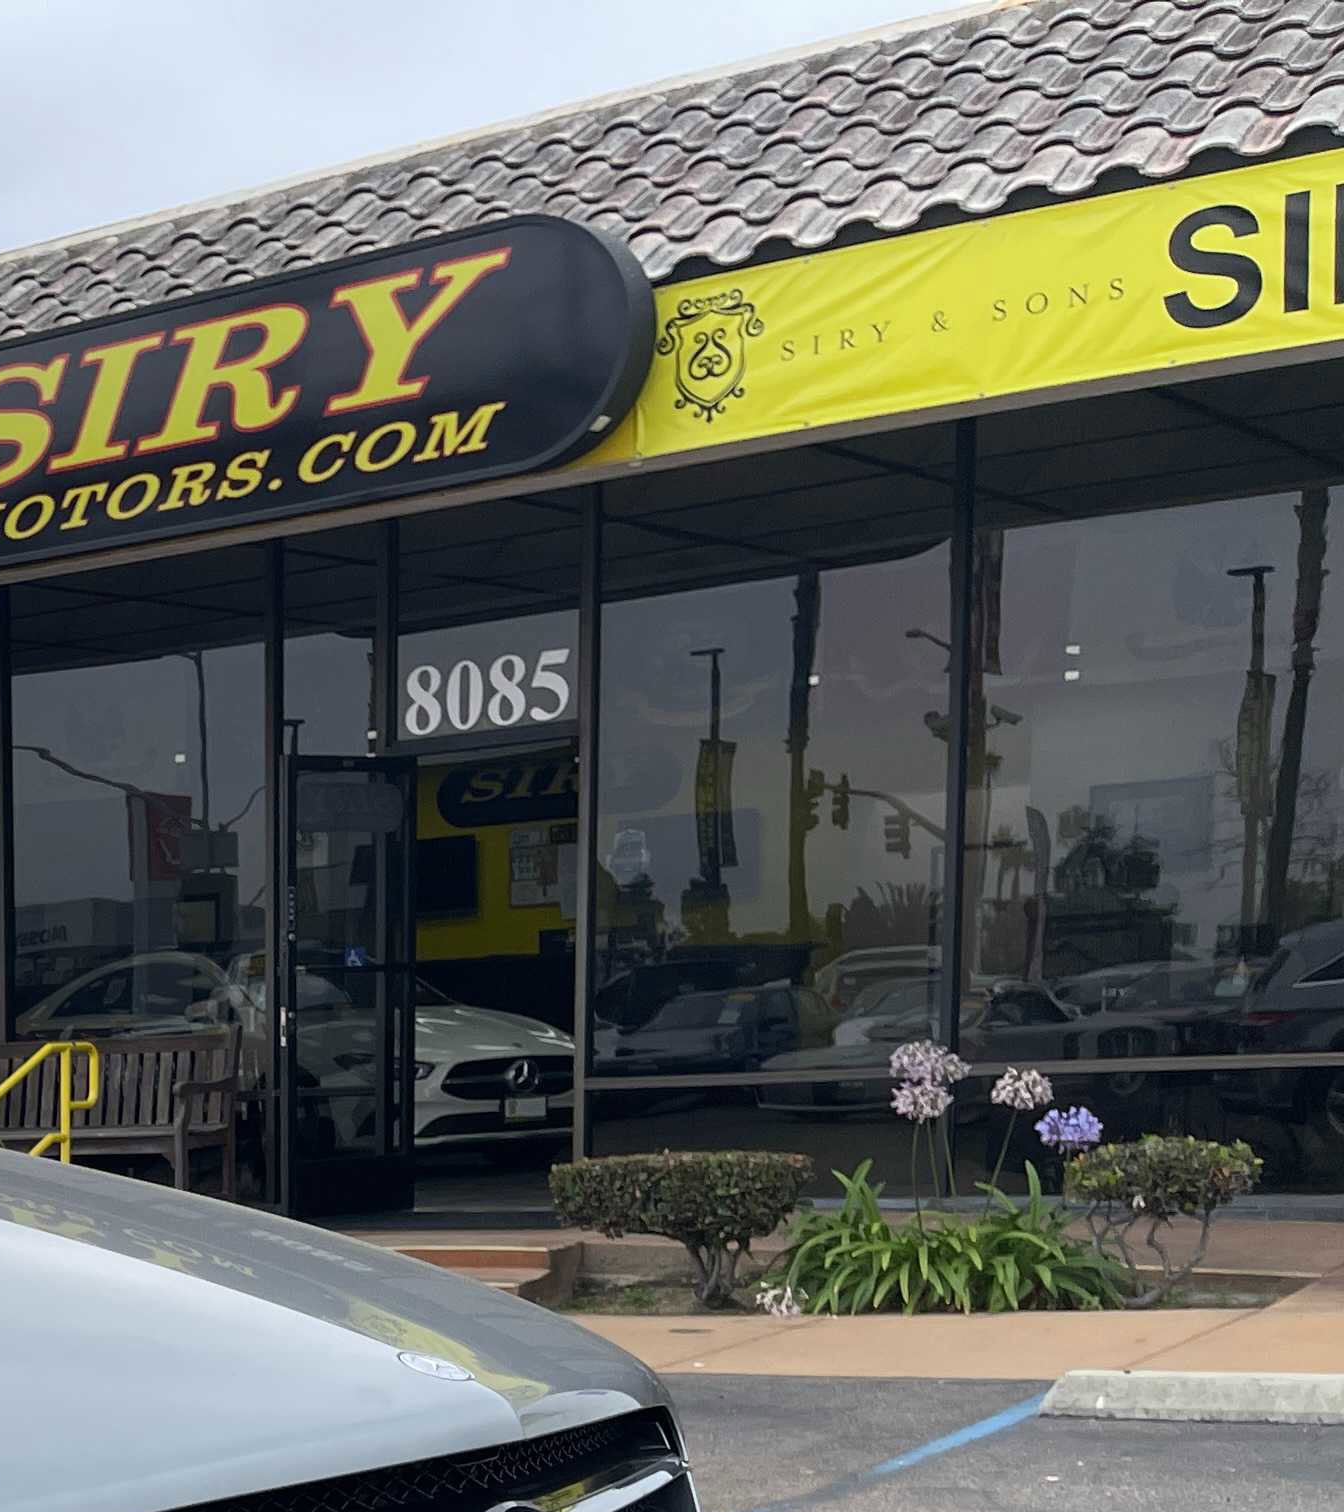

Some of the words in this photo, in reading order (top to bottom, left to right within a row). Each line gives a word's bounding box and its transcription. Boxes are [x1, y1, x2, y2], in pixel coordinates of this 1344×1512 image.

[1162, 183, 1344, 330] SI
[780, 320, 891, 362] SIRY
[931, 310, 953, 333] &
[992, 276, 1125, 323] SONS
[404, 647, 572, 736] 8085
